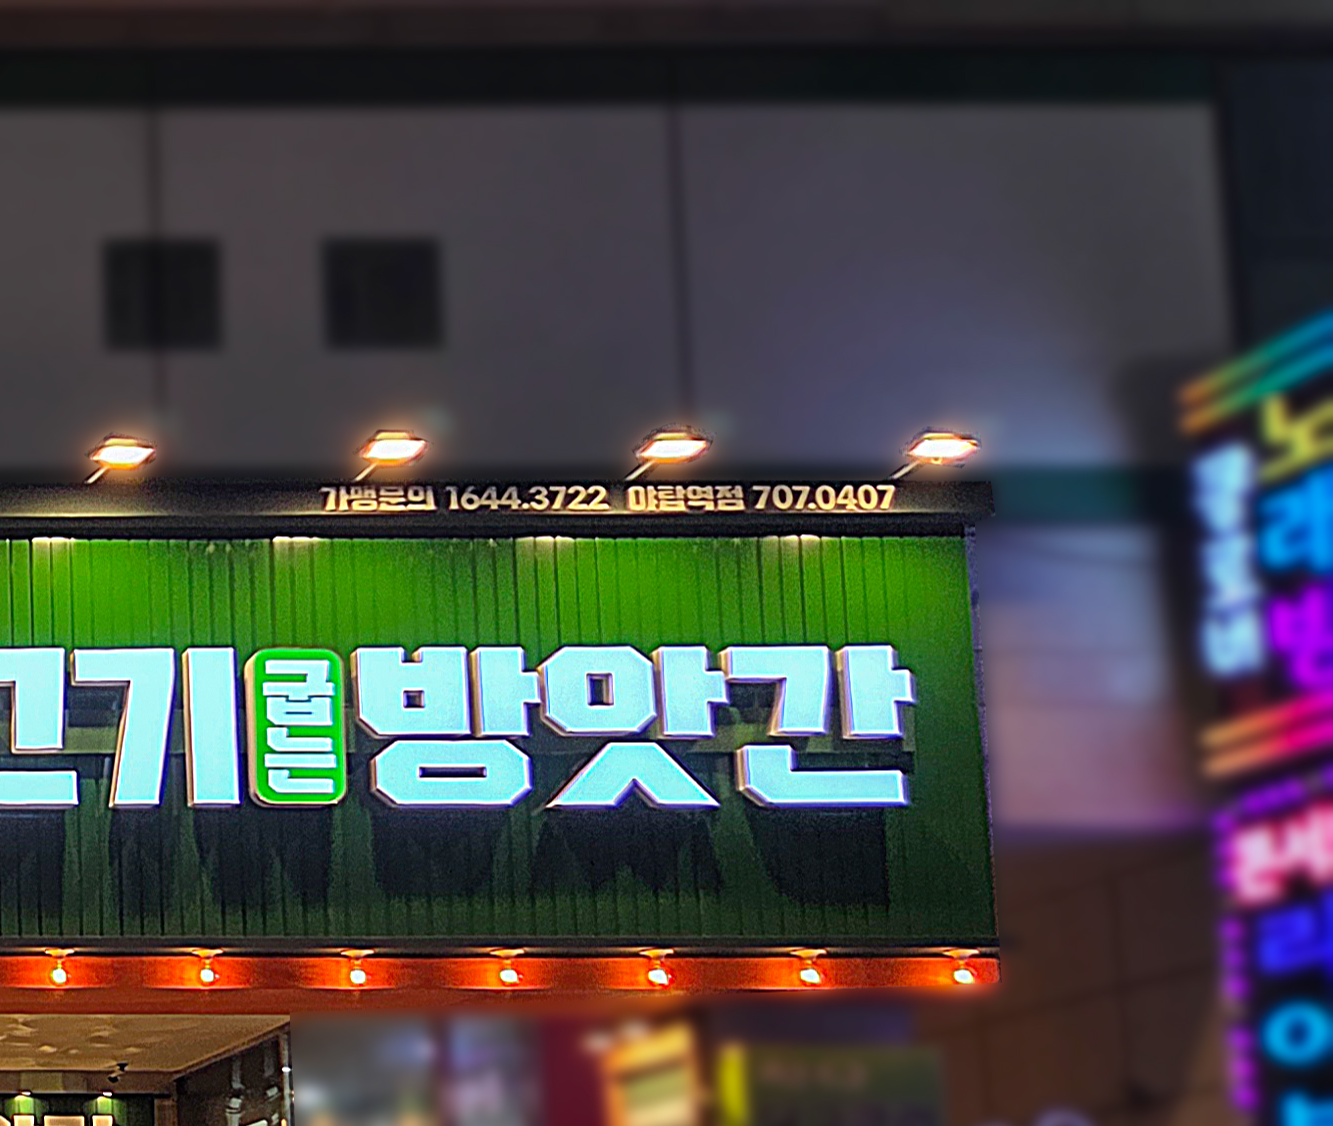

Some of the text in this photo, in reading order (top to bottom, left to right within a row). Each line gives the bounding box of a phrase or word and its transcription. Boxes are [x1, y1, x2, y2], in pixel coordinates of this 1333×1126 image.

[322, 484, 896, 512] 가맹문의 1644.3722 야탑역점 707.0407
